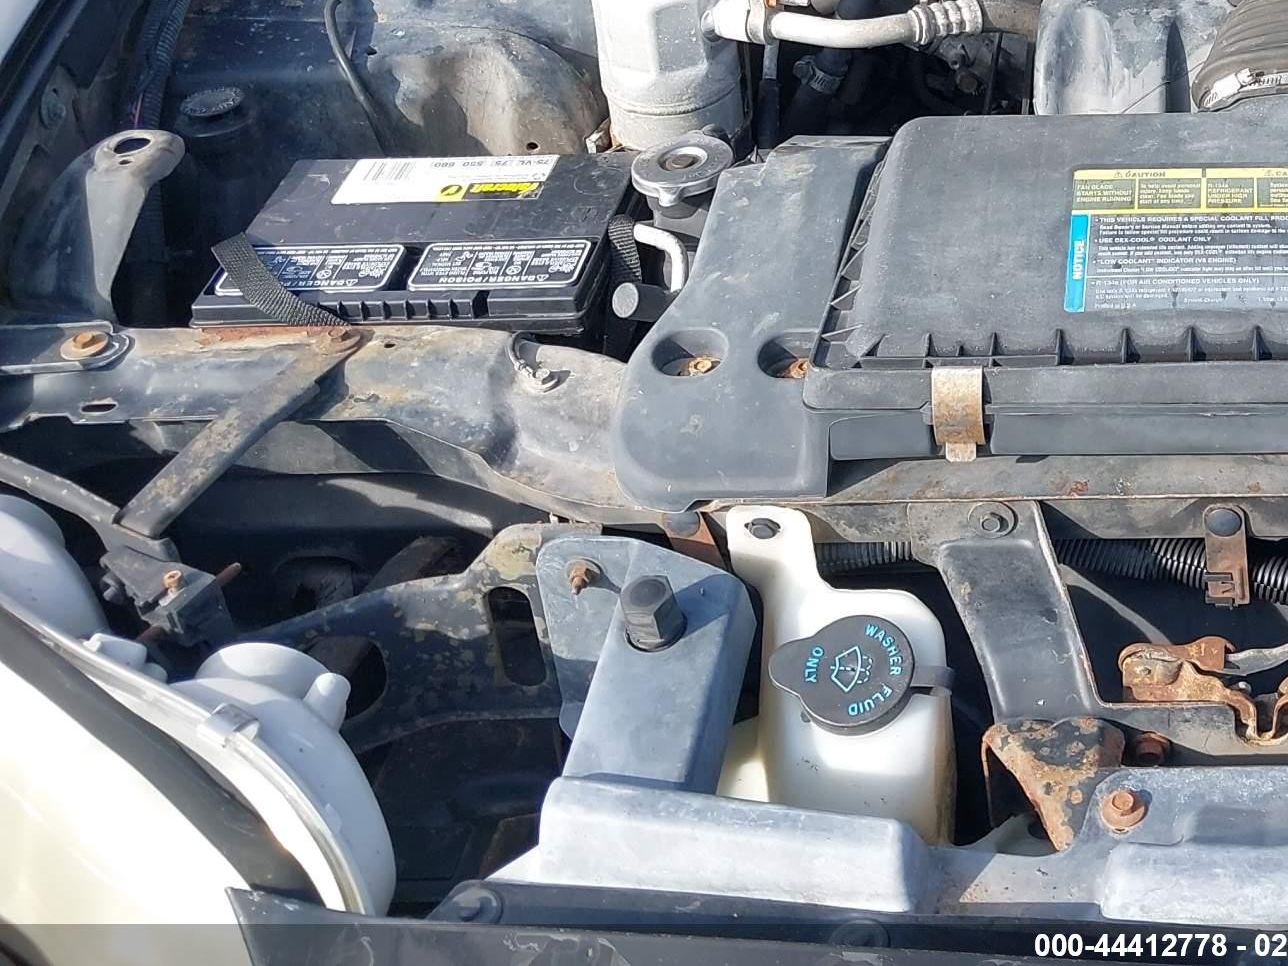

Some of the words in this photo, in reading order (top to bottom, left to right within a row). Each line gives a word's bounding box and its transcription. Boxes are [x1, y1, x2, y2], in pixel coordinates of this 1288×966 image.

[1125, 170, 1166, 178] CAUTION
[1072, 240, 1085, 280] NOTICE
[438, 275, 537, 284] DANGER/POISON
[804, 646, 825, 683] ONLY
[865, 624, 903, 676] WASHER
[848, 683, 893, 716] FLUID
